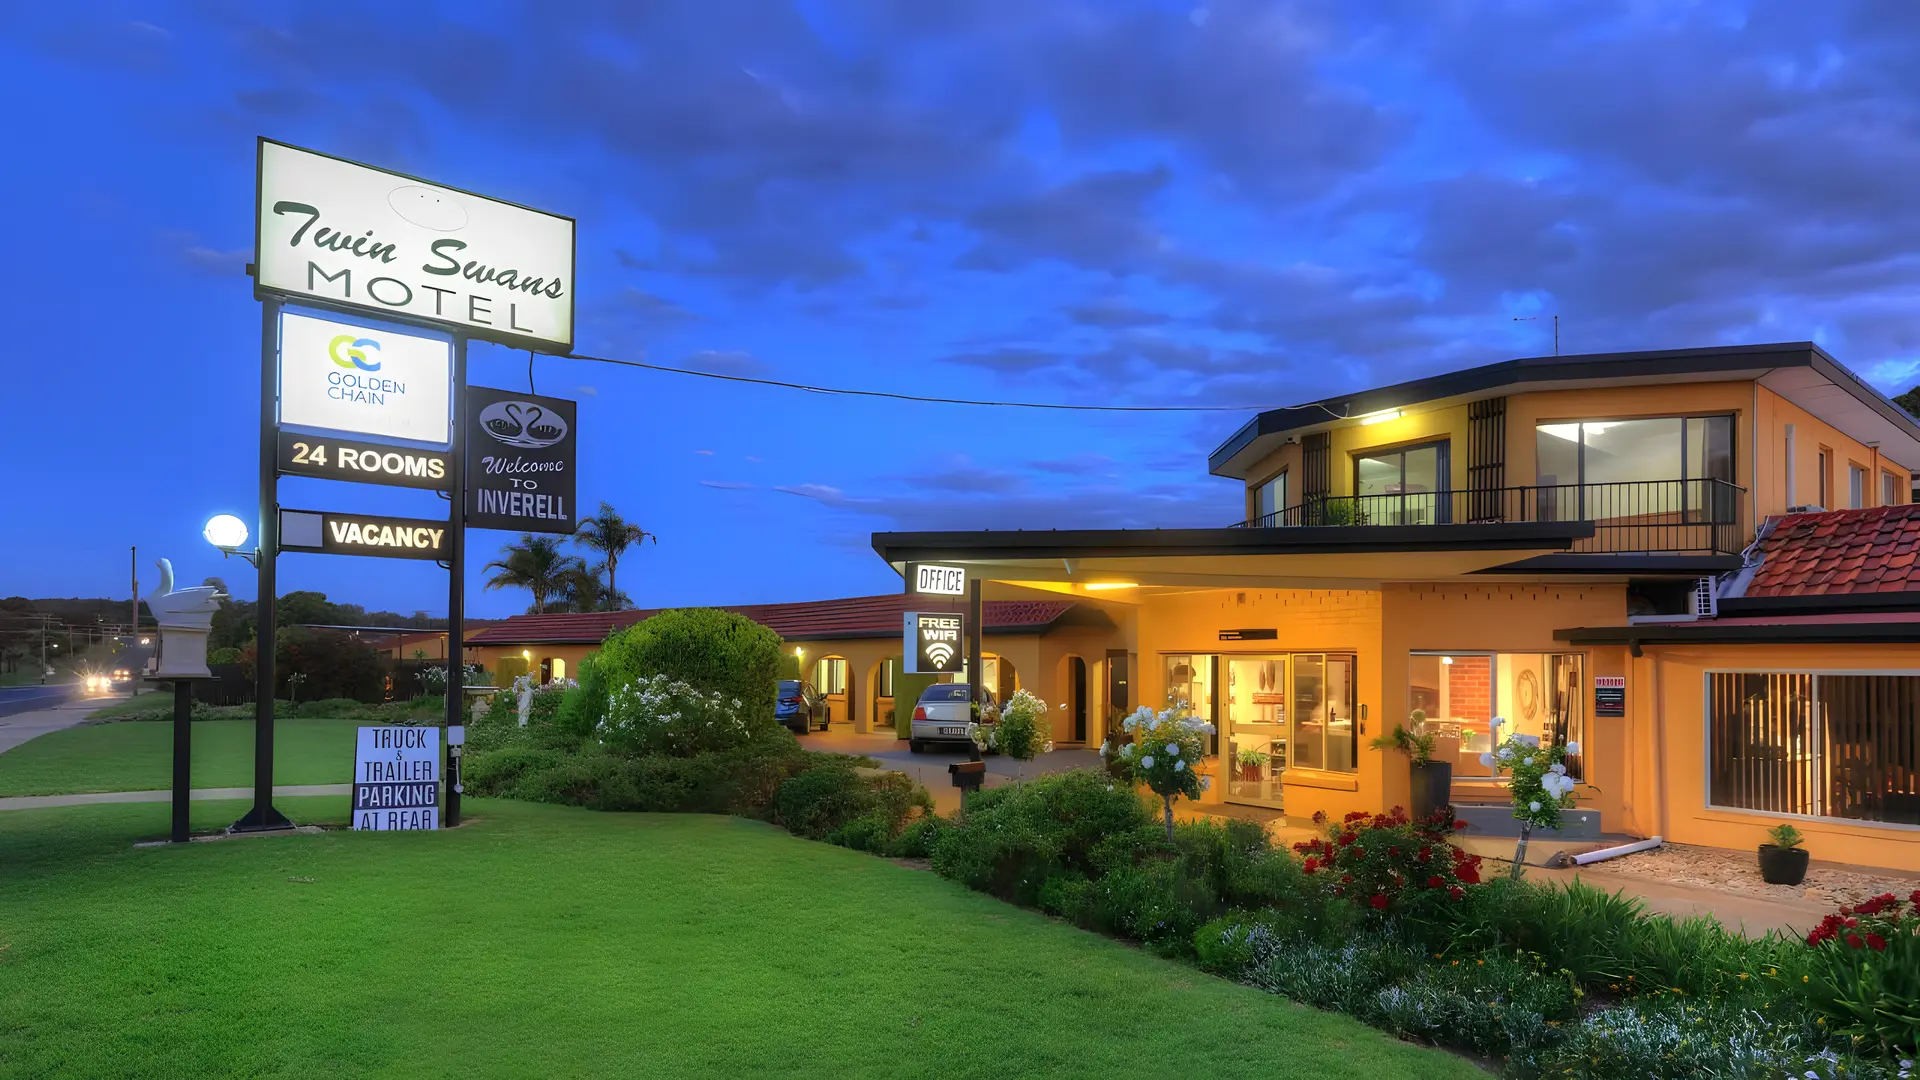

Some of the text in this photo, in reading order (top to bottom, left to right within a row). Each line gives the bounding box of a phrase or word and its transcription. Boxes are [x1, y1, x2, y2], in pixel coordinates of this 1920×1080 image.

[273, 201, 564, 299] Twin Swans
[308, 260, 533, 333] MOTEL
[328, 371, 405, 394] GOLDEN
[328, 386, 384, 405] CHAIN
[291, 442, 445, 479] 24 ROOMS
[481, 456, 564, 474] Welcome
[509, 478, 538, 490] TO
[477, 488, 568, 520] INVERELL
[329, 521, 445, 549] VACANCY
[920, 568, 962, 591] OFFICE
[918, 617, 960, 630] FREE
[373, 729, 427, 749] TRUCK
[364, 761, 432, 782] TRAILER
[358, 785, 435, 807] PARKING
[361, 810, 432, 831] AT REAR
